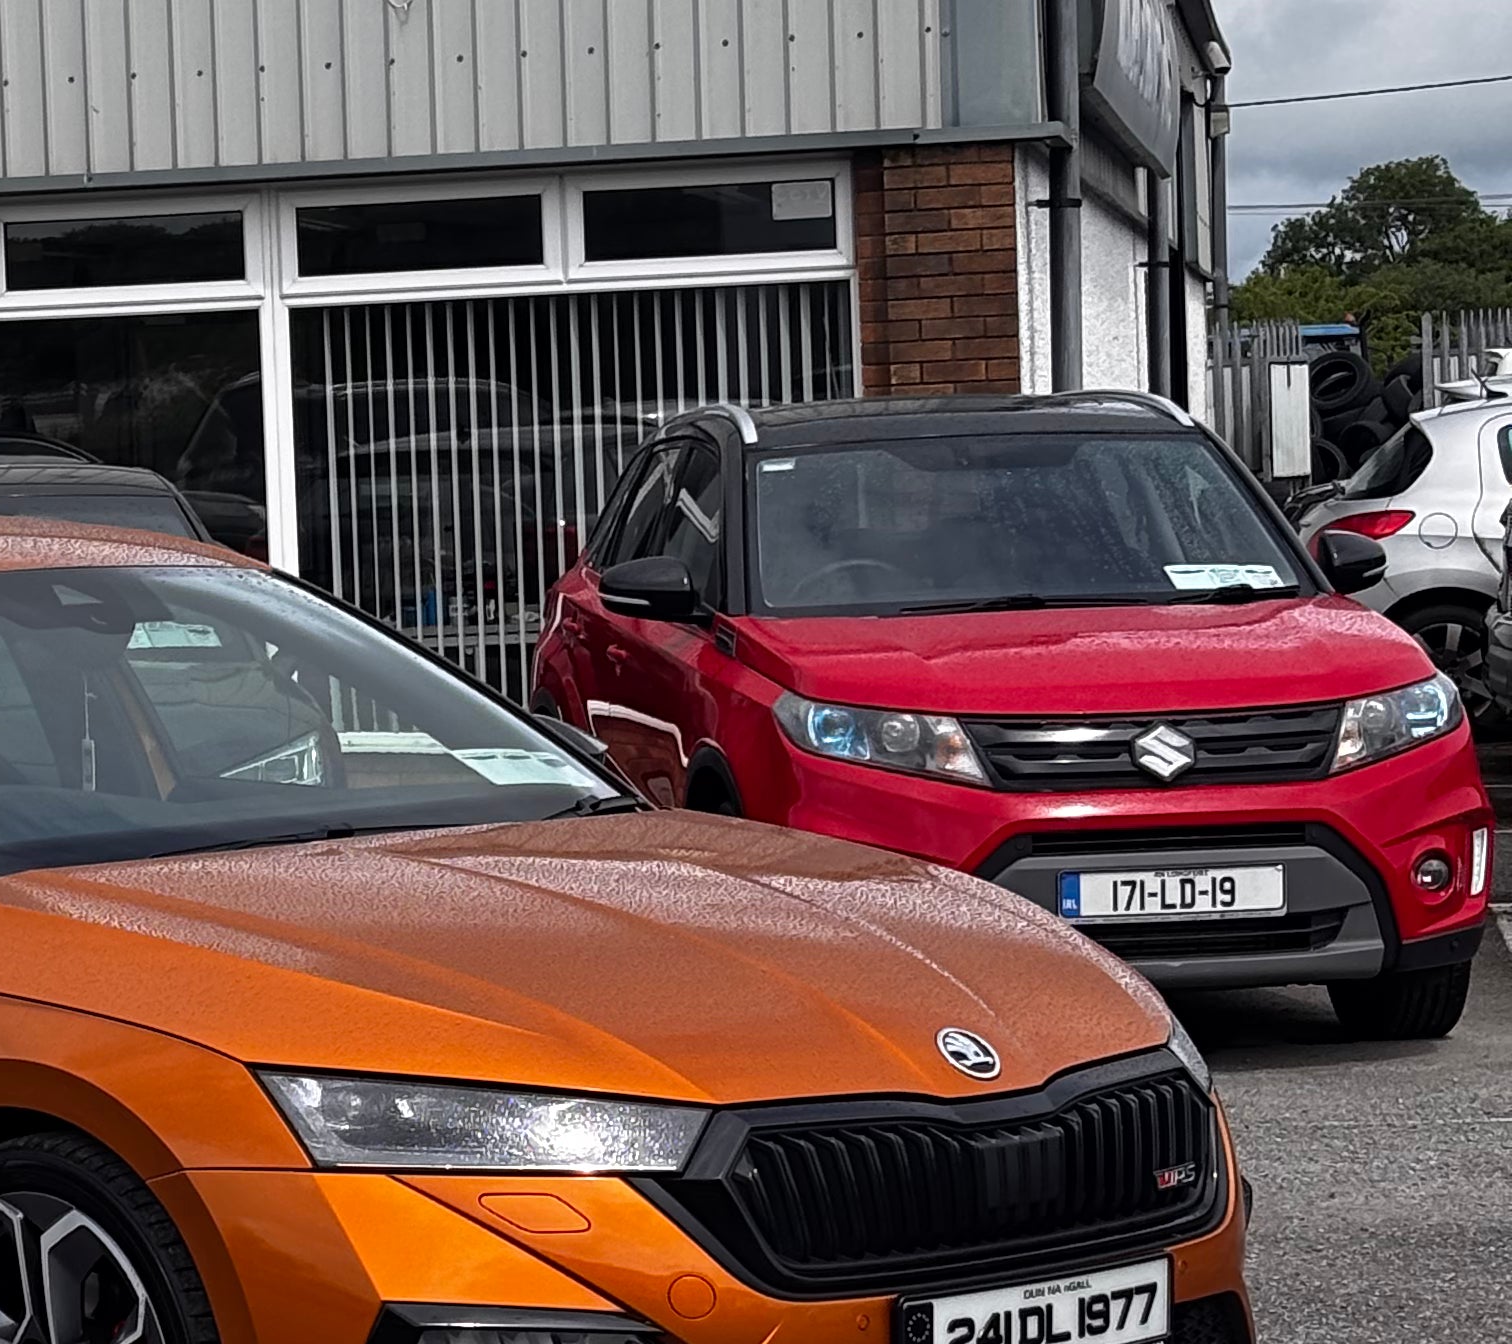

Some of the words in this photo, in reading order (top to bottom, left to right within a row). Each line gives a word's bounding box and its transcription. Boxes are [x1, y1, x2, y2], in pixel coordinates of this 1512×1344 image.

[1112, 876, 1236, 912] 171-LD-19
[1047, 1283, 1062, 1295] NA
[1078, 1281, 1158, 1339] 1977
